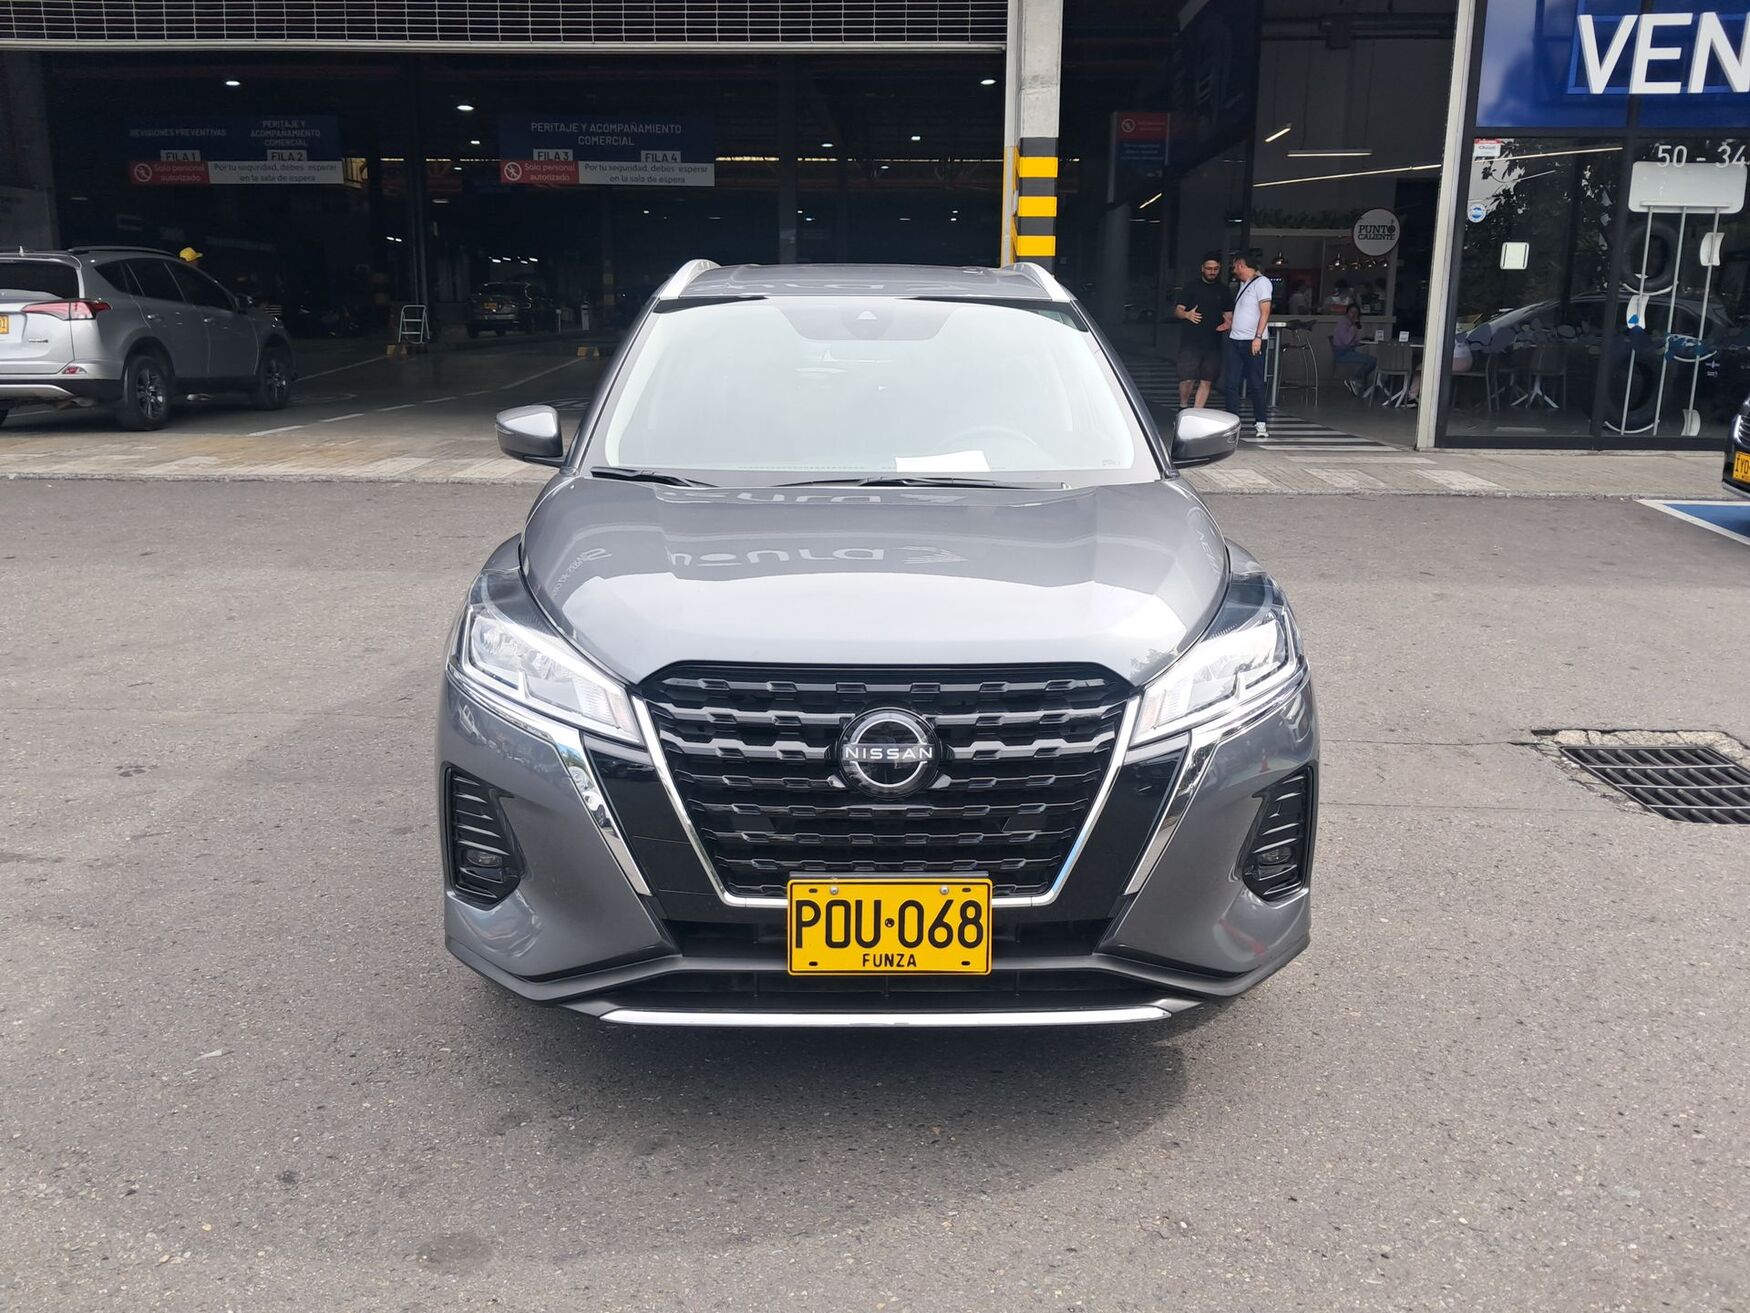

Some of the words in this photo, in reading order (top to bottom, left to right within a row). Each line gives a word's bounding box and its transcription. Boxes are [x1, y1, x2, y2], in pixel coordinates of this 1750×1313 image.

[1577, 11, 1750, 95] VEN
[530, 122, 579, 133] PERITAJE
[581, 122, 588, 132] Y
[590, 121, 682, 134] ACOMPAÑAMIENTO
[578, 135, 635, 146] COMERCIAL
[165, 151, 188, 161] FILA
[270, 151, 295, 161] FILA
[296, 151, 304, 161] 2
[537, 151, 561, 161] FILA
[562, 151, 569, 161] 3
[644, 152, 669, 163] FILA
[671, 153, 678, 163] 4
[1656, 144, 1688, 168] 50
[542, 162, 575, 173] personal
[584, 162, 597, 171] Por
[599, 162, 607, 171] tu
[678, 165, 708, 174] esperar
[529, 172, 570, 182] autorizado
[630, 174, 645, 183] sala
[659, 176, 686, 184] espera
[1358, 224, 1396, 234] PUNTO
[845, 746, 933, 760] NISSAN
[862, 952, 918, 968] FUNZA
